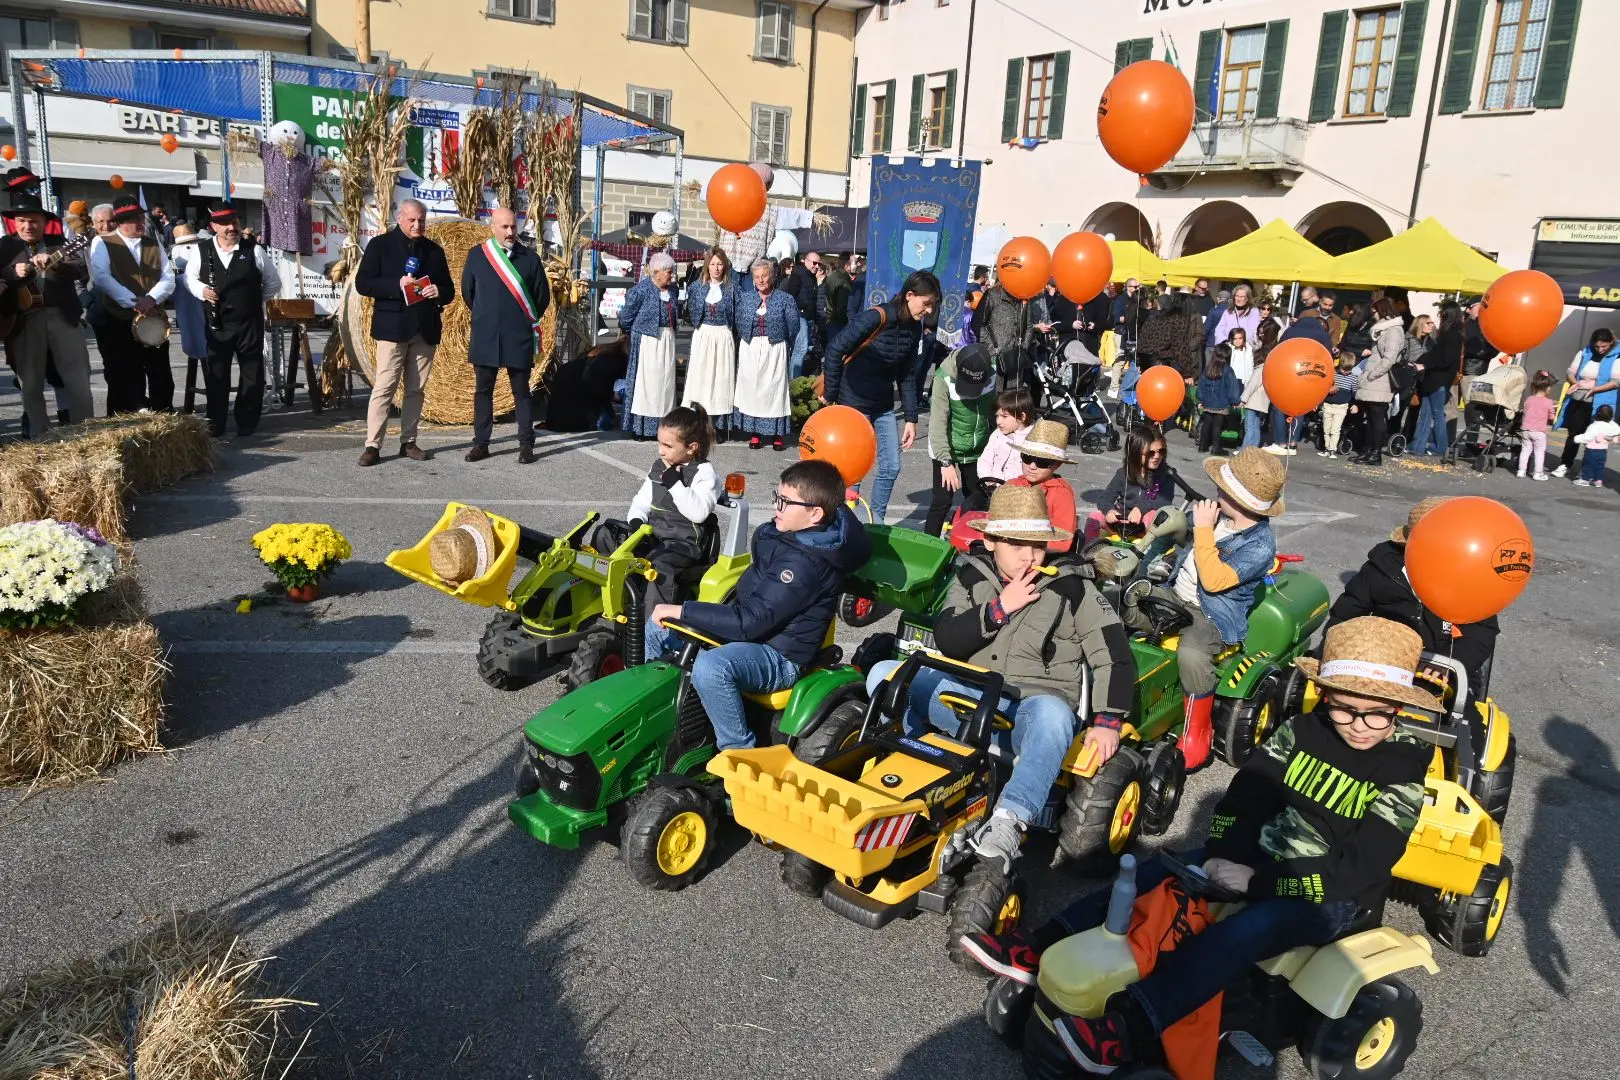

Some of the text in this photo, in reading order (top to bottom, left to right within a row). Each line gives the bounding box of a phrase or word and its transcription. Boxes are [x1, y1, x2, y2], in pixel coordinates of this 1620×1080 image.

[117, 108, 181, 133] BAR
[414, 187, 457, 202] ITALIA
[1556, 223, 1589, 231] COMUNE
[1570, 232, 1618, 240] Informazioni
